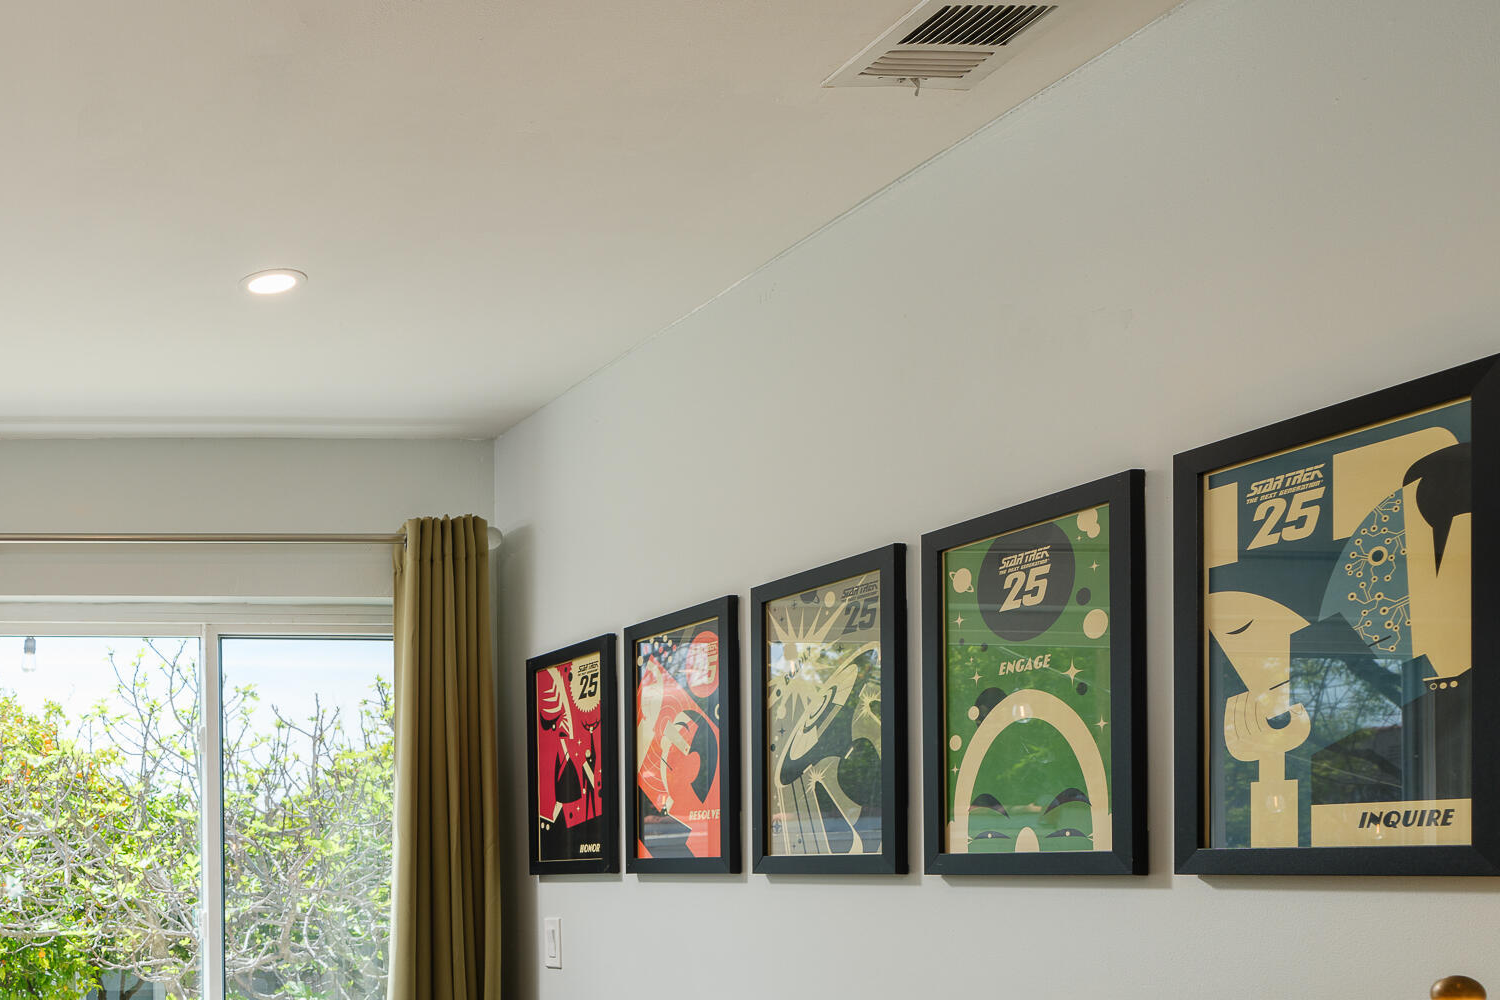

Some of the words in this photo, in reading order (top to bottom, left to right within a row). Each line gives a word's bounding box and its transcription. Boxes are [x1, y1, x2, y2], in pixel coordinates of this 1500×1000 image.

[1249, 476, 1285, 498] STAR
[1285, 463, 1326, 491] TREK
[1279, 480, 1324, 495] GENERATION
[1246, 486, 1326, 551] 25
[999, 554, 1024, 571] STAR
[1023, 545, 1051, 565] TREK
[999, 563, 1051, 613] 25
[841, 596, 879, 635] 25
[783, 645, 812, 686] BOLDLY
[998, 654, 1052, 676] ENGAGE
[579, 671, 599, 700] 25
[689, 809, 720, 820] RESOLVE
[1357, 808, 1456, 829] INQUIRE
[579, 843, 601, 854] HONOR
